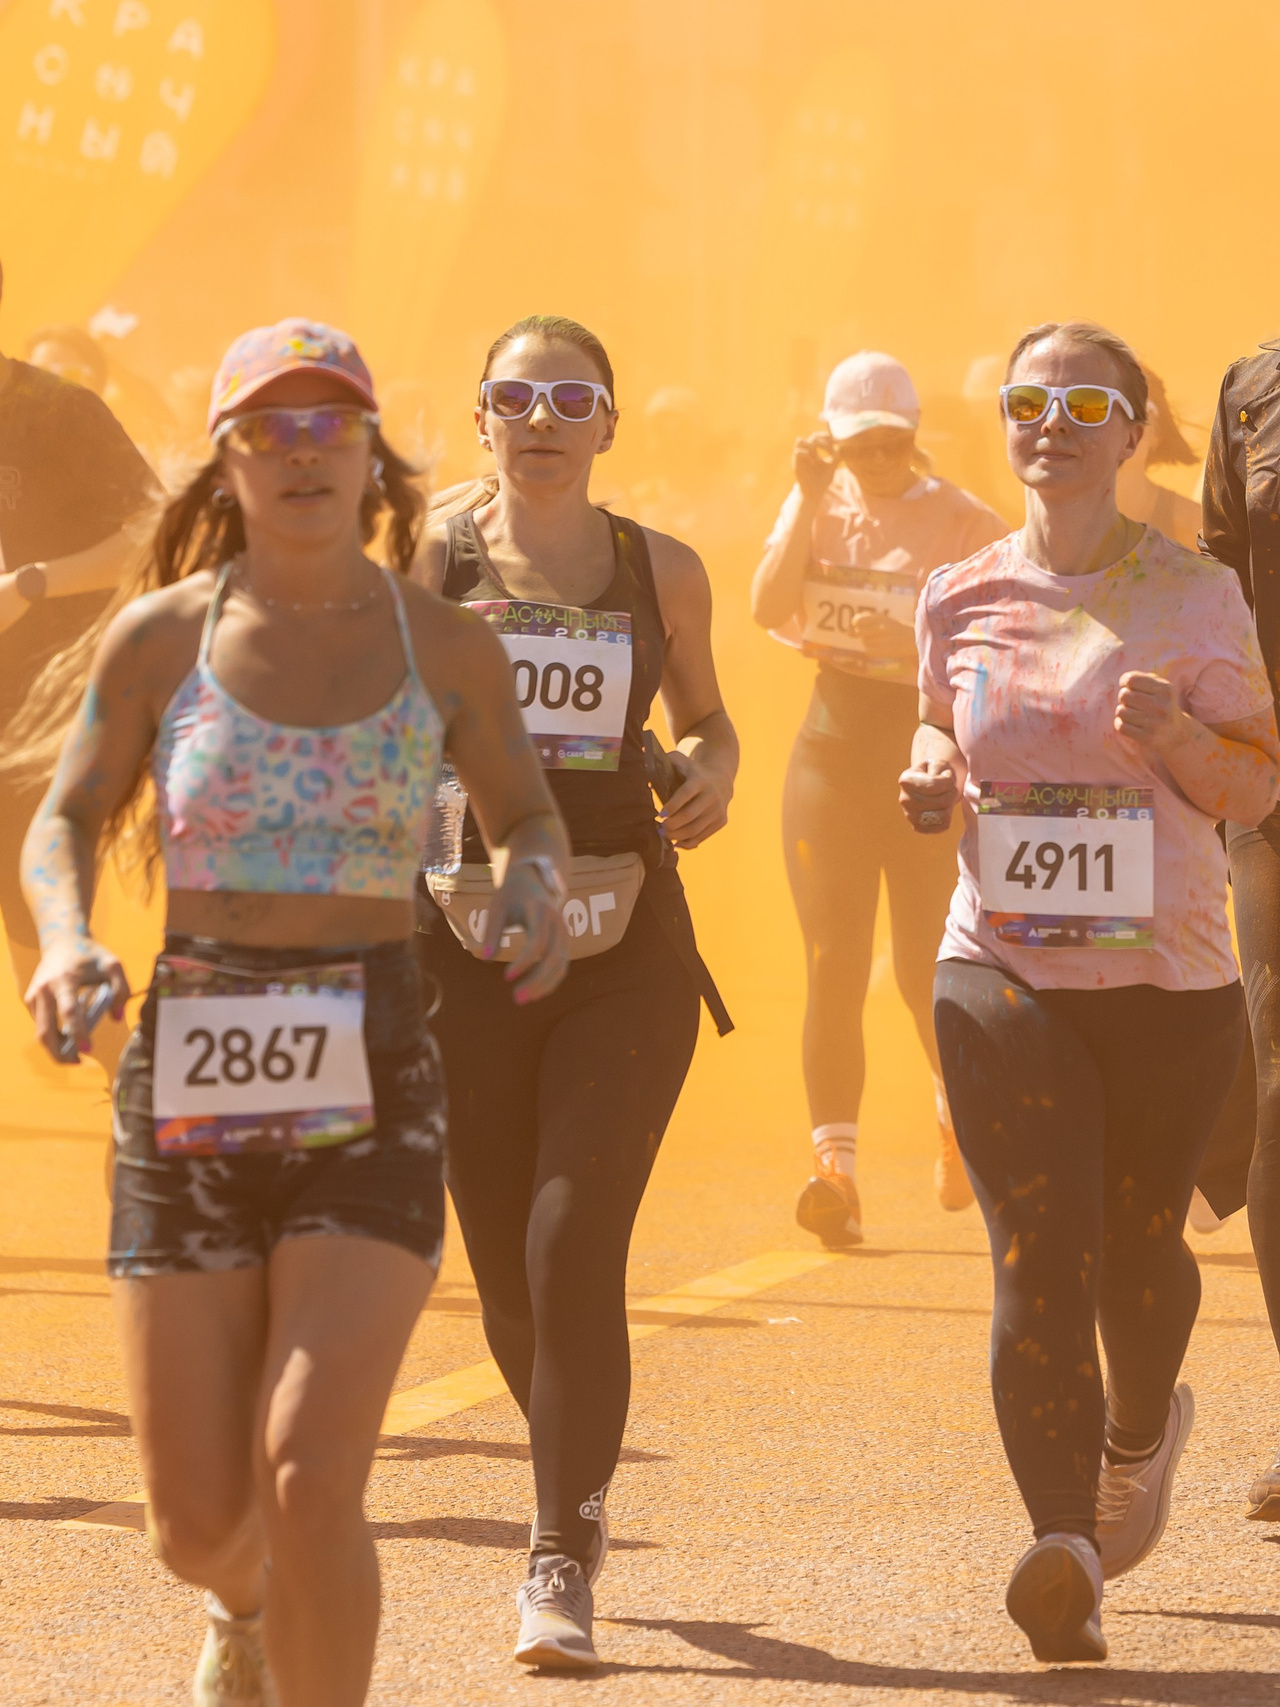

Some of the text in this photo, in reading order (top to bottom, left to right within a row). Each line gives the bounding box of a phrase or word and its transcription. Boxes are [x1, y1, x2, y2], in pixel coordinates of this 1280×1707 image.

[817, 600, 890, 633] 20
[555, 627, 628, 645] 2026
[513, 659, 604, 712] 008
[994, 785, 1138, 807] КРАСОЧНЫЙ
[1076, 807, 1150, 820] 2026
[1005, 841, 1113, 892] 4911
[184, 1025, 329, 1087] 2867
